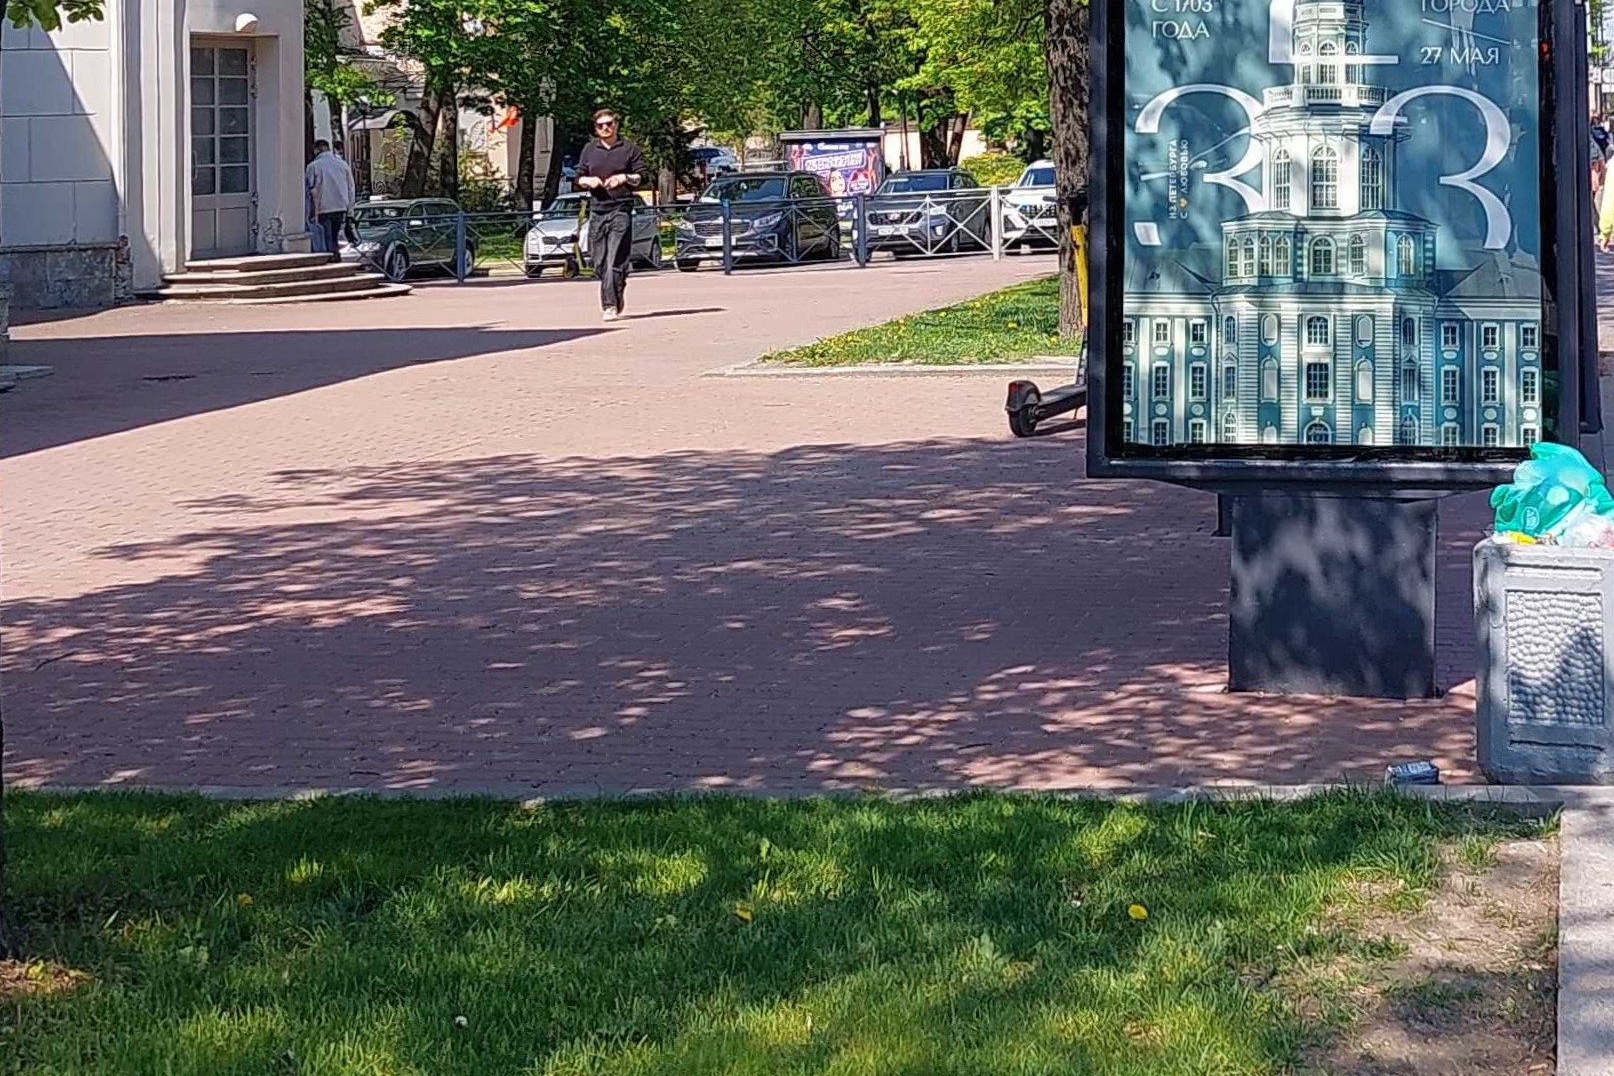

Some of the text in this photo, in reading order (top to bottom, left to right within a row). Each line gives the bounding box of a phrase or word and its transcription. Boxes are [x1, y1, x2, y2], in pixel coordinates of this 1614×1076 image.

[1152, 20, 1210, 40] ГОДА
[1420, 47, 1499, 64] 27 МАЯ
[1169, 139, 1177, 203] ПЕТЕРБУРГА
[1180, 139, 1188, 193] ЛЮБОВЬЮ
